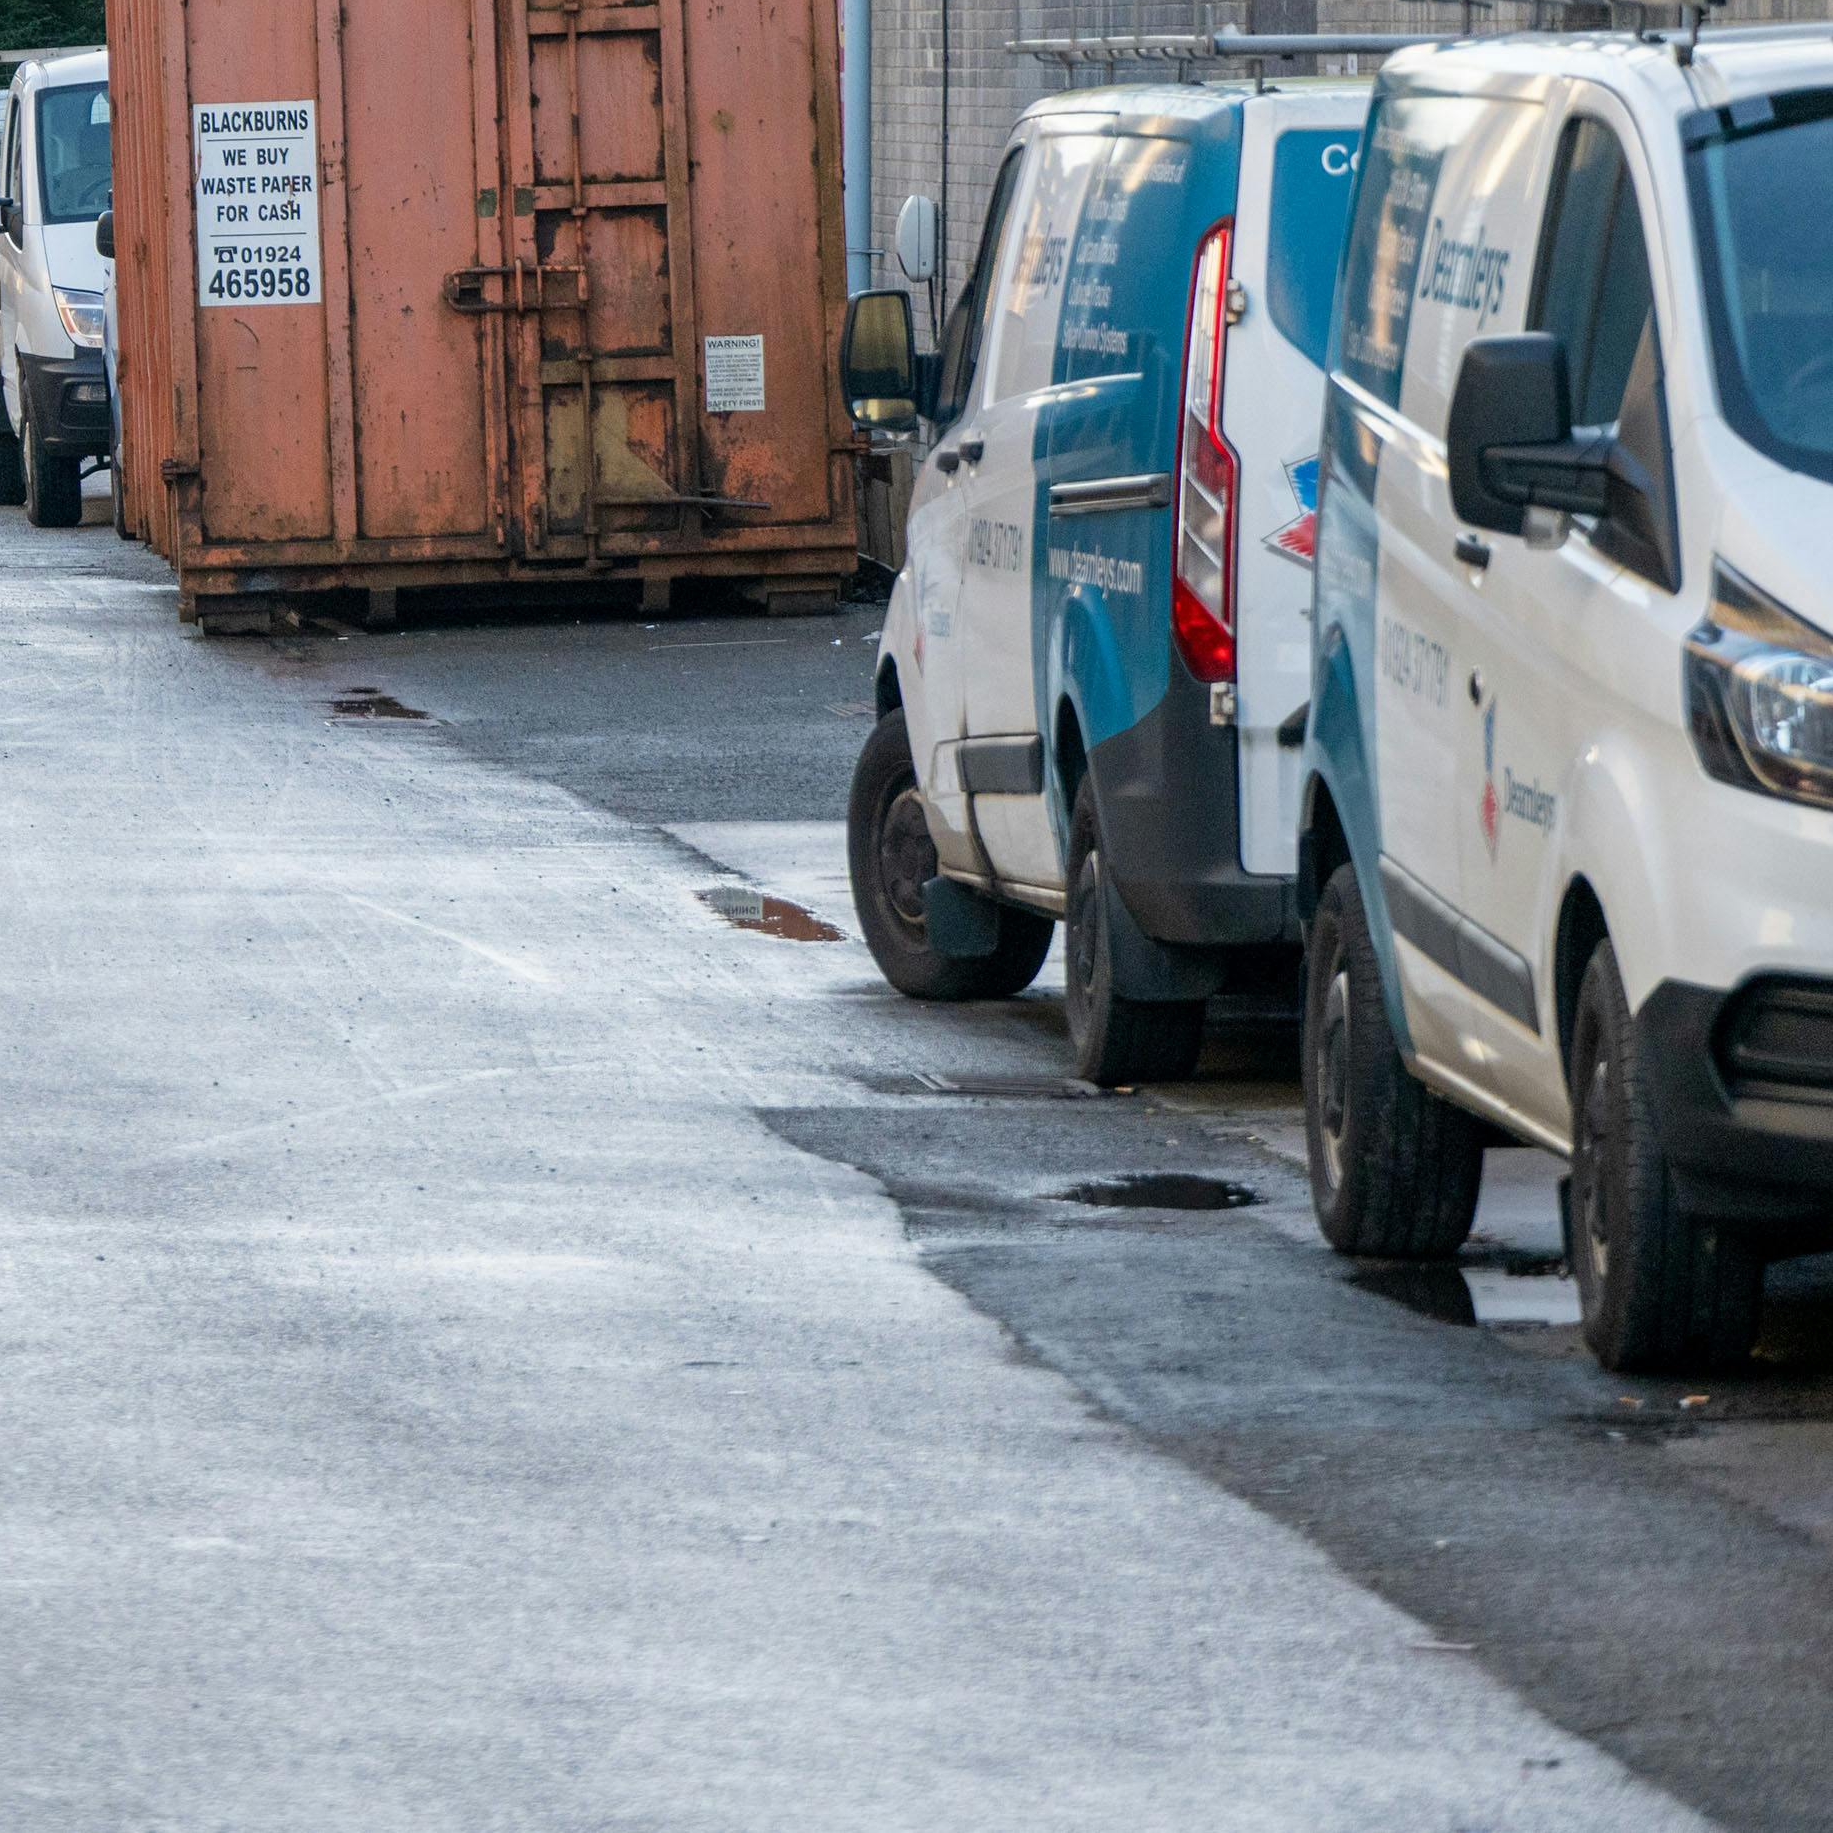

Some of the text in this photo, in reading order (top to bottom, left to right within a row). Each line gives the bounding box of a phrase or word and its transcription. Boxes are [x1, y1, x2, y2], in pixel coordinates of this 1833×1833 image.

[200, 109, 309, 133] BLACKBURNS
[223, 147, 289, 166] WE BUY
[201, 175, 312, 195] WASTE PAPER
[216, 203, 301, 222] FOR CASH
[241, 245, 301, 263] 01924
[209, 267, 311, 298] 465958
[1419, 217, 1510, 331] Dearnleys
[707, 339, 760, 348] WARNING!
[708, 400, 737, 408] SAFETY
